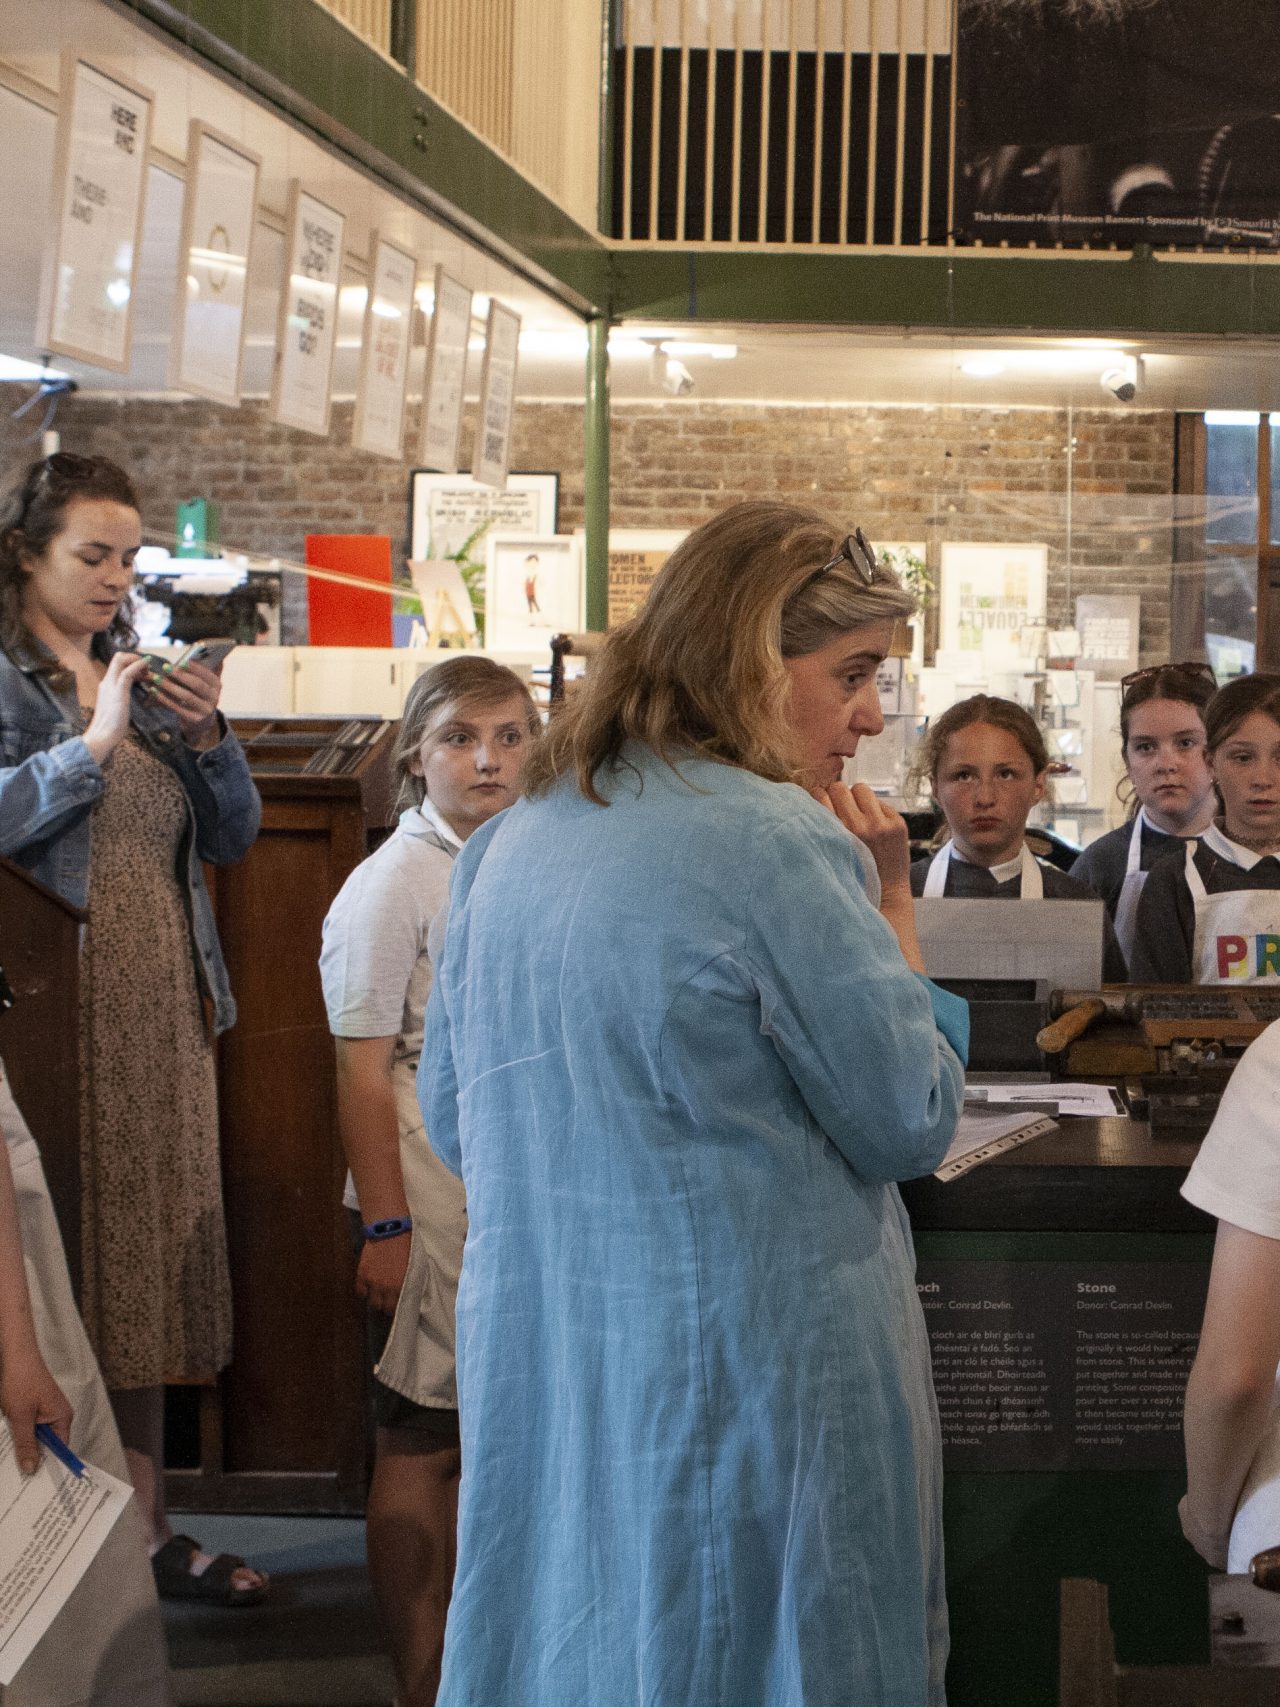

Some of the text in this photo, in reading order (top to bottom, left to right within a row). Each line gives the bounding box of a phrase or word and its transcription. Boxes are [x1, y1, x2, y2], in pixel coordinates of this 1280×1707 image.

[974, 212, 991, 221] The
[994, 213, 1035, 222] National
[1037, 213, 1060, 222] Print
[1062, 213, 1103, 222] Museum
[1105, 214, 1144, 224] Banners
[1147, 215, 1198, 226] Sponsored
[1200, 216, 1215, 228] by
[1233, 218, 1271, 228] Smurfit
[610, 554, 645, 563] OMEN
[917, 1283, 940, 1293] och
[1077, 1283, 1117, 1293] Stone
[948, 1301, 981, 1309] Conrad
[1077, 1301, 1108, 1309] Donor:
[1110, 1301, 1142, 1309] Conrad
[931, 1331, 954, 1339] cloch
[957, 1331, 969, 1339] air
[971, 1331, 981, 1339] de
[1077, 1331, 1093, 1339] The
[1122, 1331, 1129, 1339] is
[1131, 1331, 1168, 1339] so-called
[1076, 1345, 1114, 1354] originally
[980, 1357, 988, 1366] le
[1018, 1359, 1036, 1368] agus
[1076, 1357, 1096, 1365] from
[1129, 1357, 1146, 1365] This
[1149, 1357, 1155, 1365] is
[1157, 1357, 1184, 1365] where
[1076, 1372, 1089, 1380] put
[1093, 1371, 1129, 1380] together
[1139, 1384, 1185, 1393] composito
[1076, 1398, 1095, 1406] pour
[1150, 1397, 1172, 1406] ready
[989, 1411, 1000, 1420] go
[1141, 1410, 1165, 1419] sticky
[967, 1424, 985, 1433] agus
[987, 1424, 998, 1433] go
[1076, 1423, 1180, 1432] would stick together and
